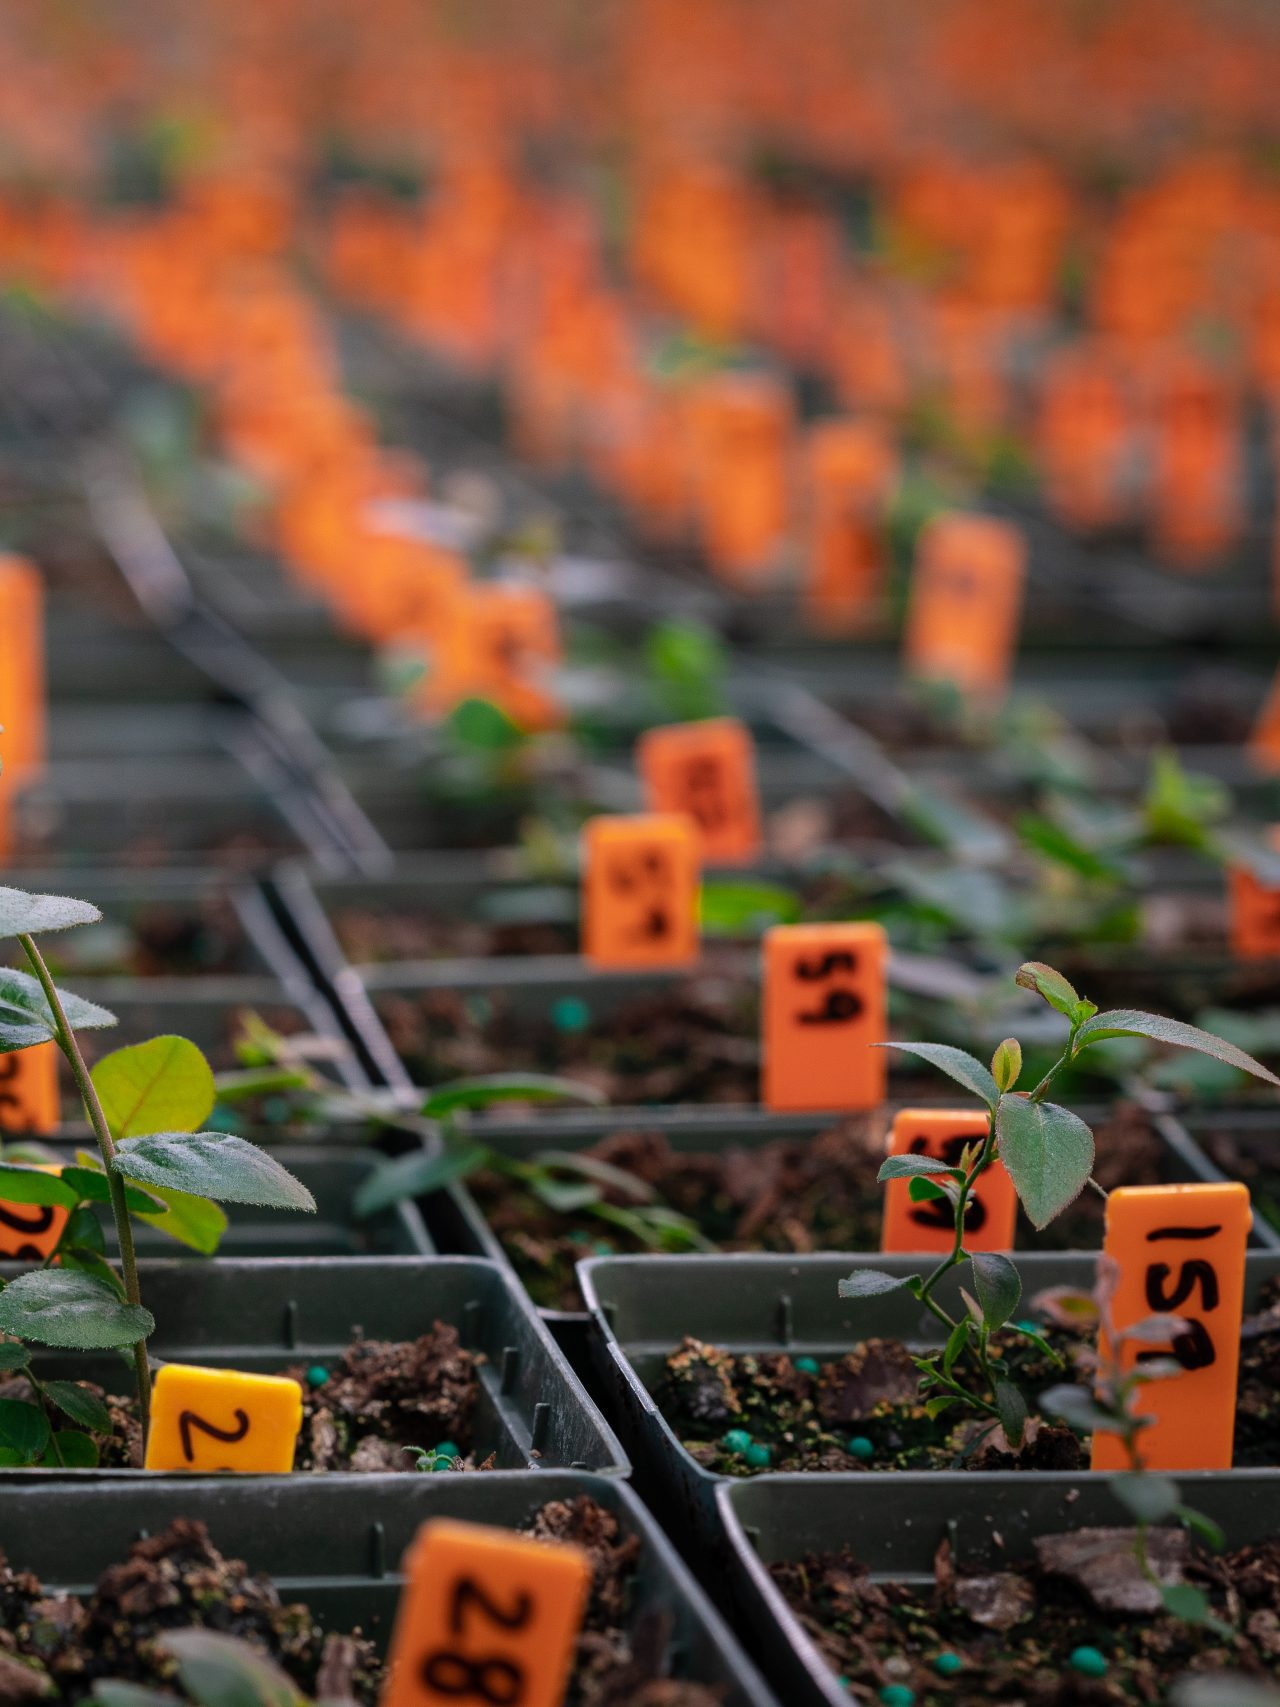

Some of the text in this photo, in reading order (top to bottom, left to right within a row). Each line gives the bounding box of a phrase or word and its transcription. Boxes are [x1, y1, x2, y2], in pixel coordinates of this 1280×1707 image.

[793, 950, 864, 1027] 59
[178, 1407, 251, 1472] 2
[417, 1567, 537, 1707] 28
